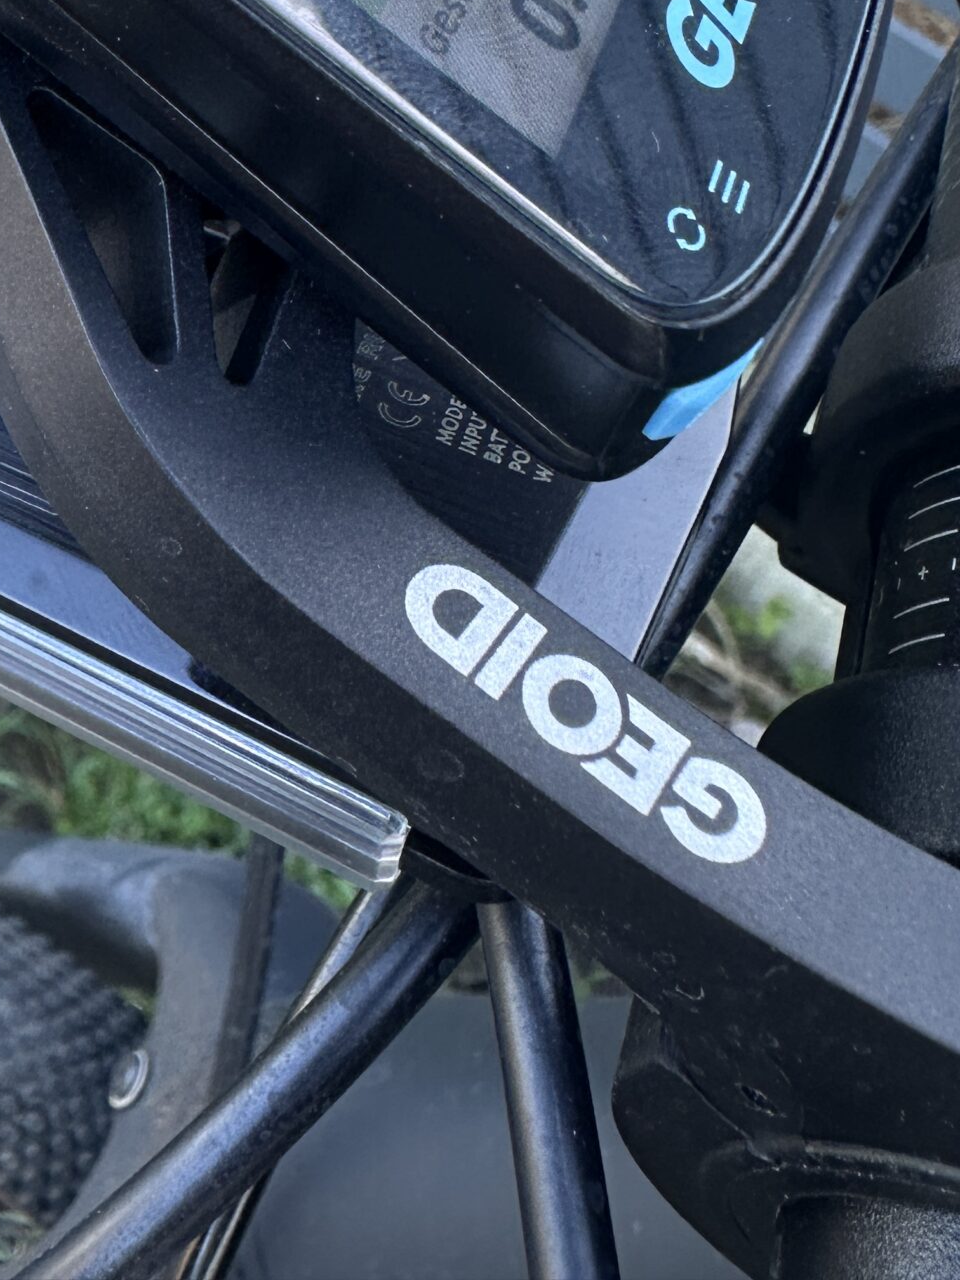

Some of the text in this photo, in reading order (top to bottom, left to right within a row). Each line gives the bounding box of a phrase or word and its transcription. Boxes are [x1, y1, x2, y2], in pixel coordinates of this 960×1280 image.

[435, 394, 468, 447] MODE
[457, 410, 488, 457] INPU
[507, 444, 532, 475] PO
[403, 563, 767, 865] GEOID
